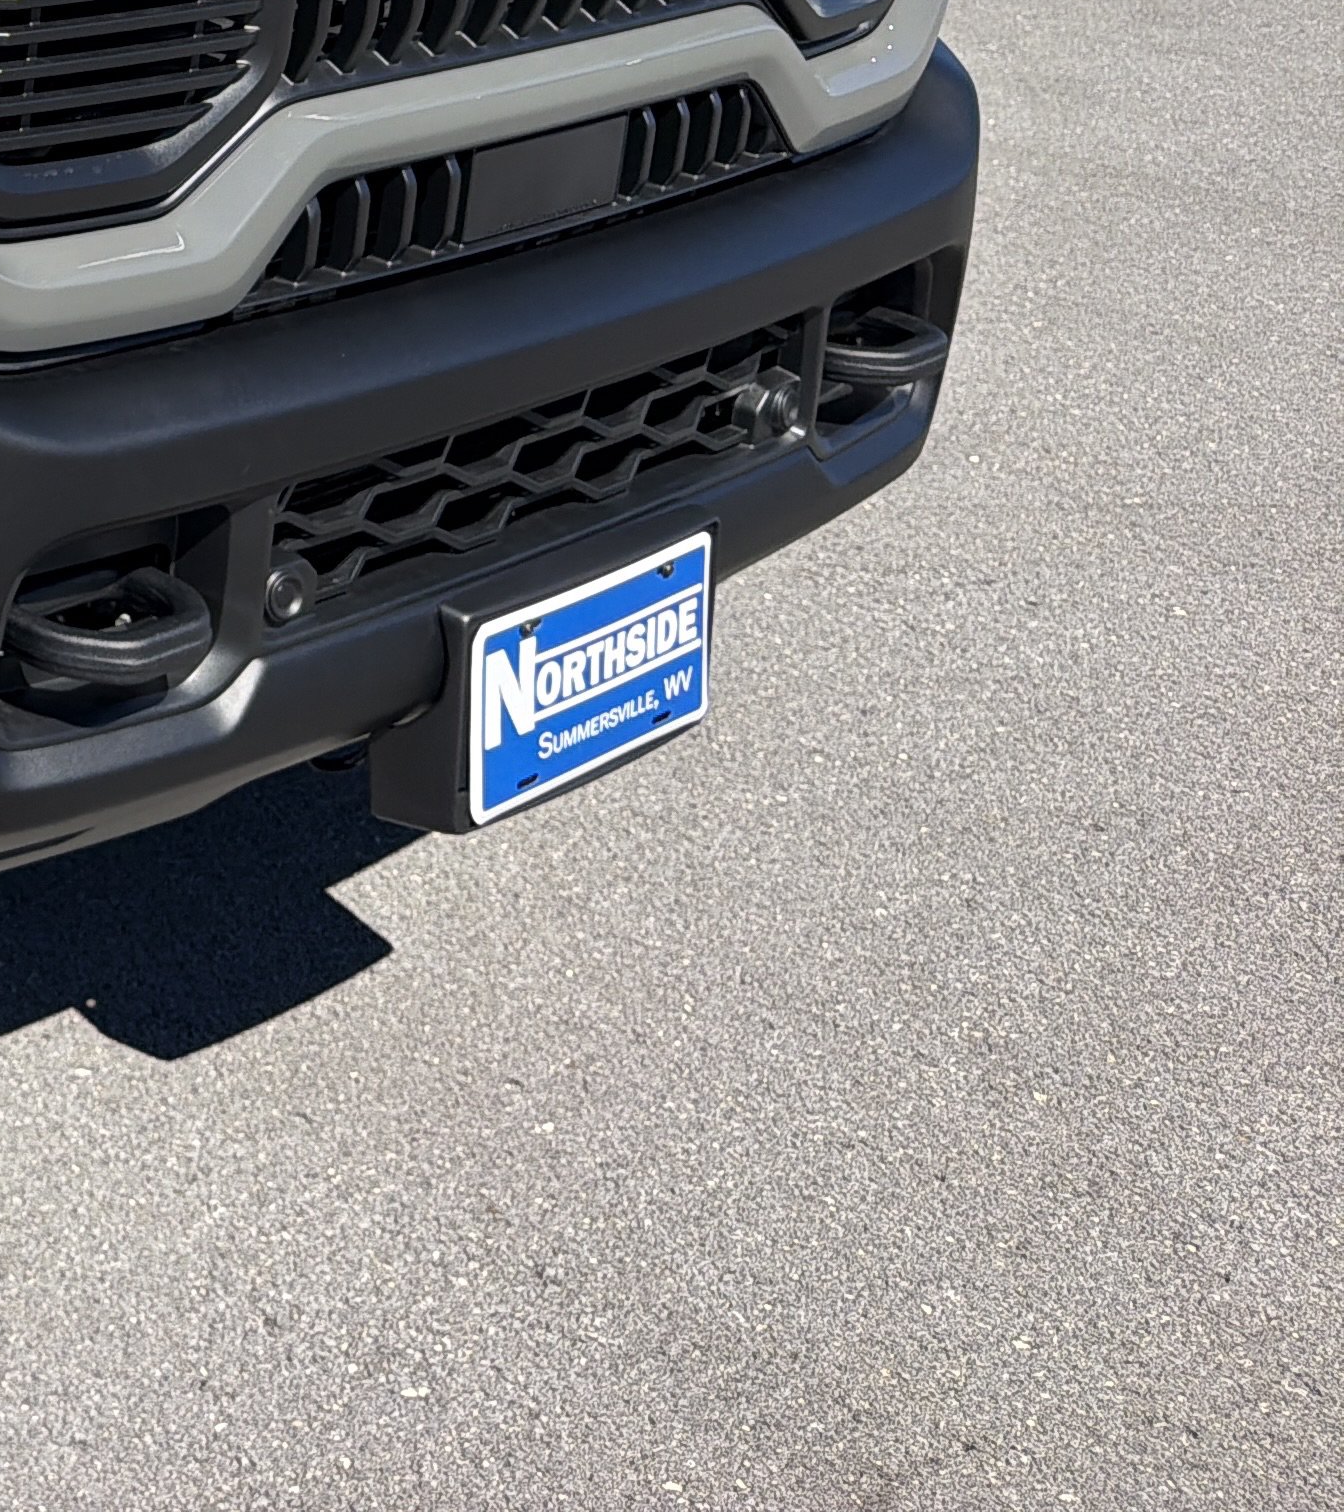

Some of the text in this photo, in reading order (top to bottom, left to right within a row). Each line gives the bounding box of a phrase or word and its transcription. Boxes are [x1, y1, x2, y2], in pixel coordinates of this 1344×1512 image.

[485, 598, 698, 751] NORTHSIDE
[538, 666, 694, 759] SUMMERSVILLE, WV
